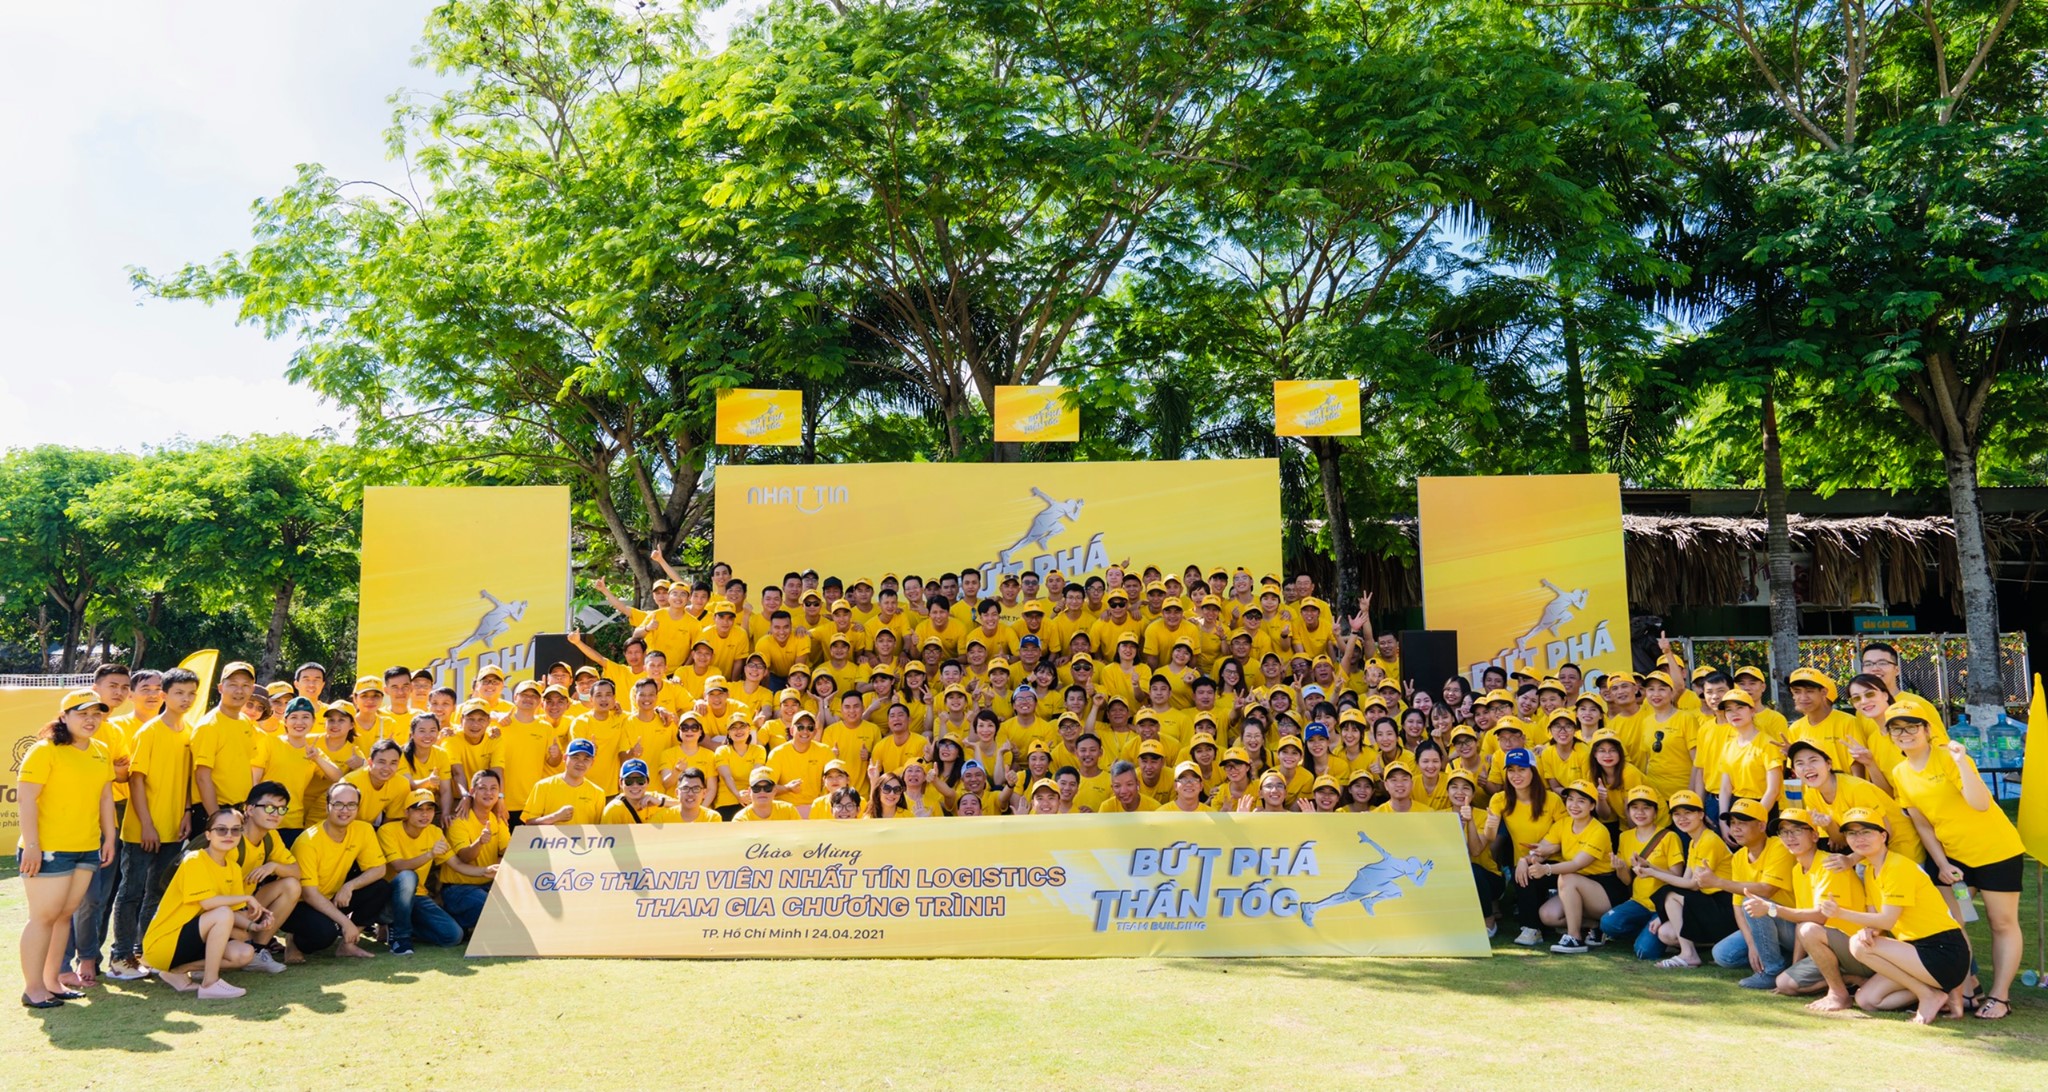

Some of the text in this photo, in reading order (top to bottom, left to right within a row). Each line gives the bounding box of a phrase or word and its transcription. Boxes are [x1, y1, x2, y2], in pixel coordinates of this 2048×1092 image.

[747, 486, 849, 505] NHAT TIN
[1032, 532, 1110, 585] PHÁ
[1546, 620, 1616, 669] PHÁ
[530, 836, 615, 850] NHAT TIN
[745, 842, 862, 866] Chào Mừng
[1129, 840, 1321, 879] BỨT PHÁ
[533, 863, 1067, 892] CÁC THÀNH VIÊN NHẤT TÍN LOGISTICS
[636, 892, 1005, 918] THAM GIA CHƯƠNG TRÌNH
[1092, 878, 1301, 932] THẦN TỐC
[702, 928, 720, 939] TP.
[723, 927, 741, 939] Hồ
[744, 927, 767, 939] Chí
[769, 928, 802, 939] Minh
[812, 928, 885, 940] 24.04.2021
[1116, 921, 1207, 931] TEAM BUILDING
